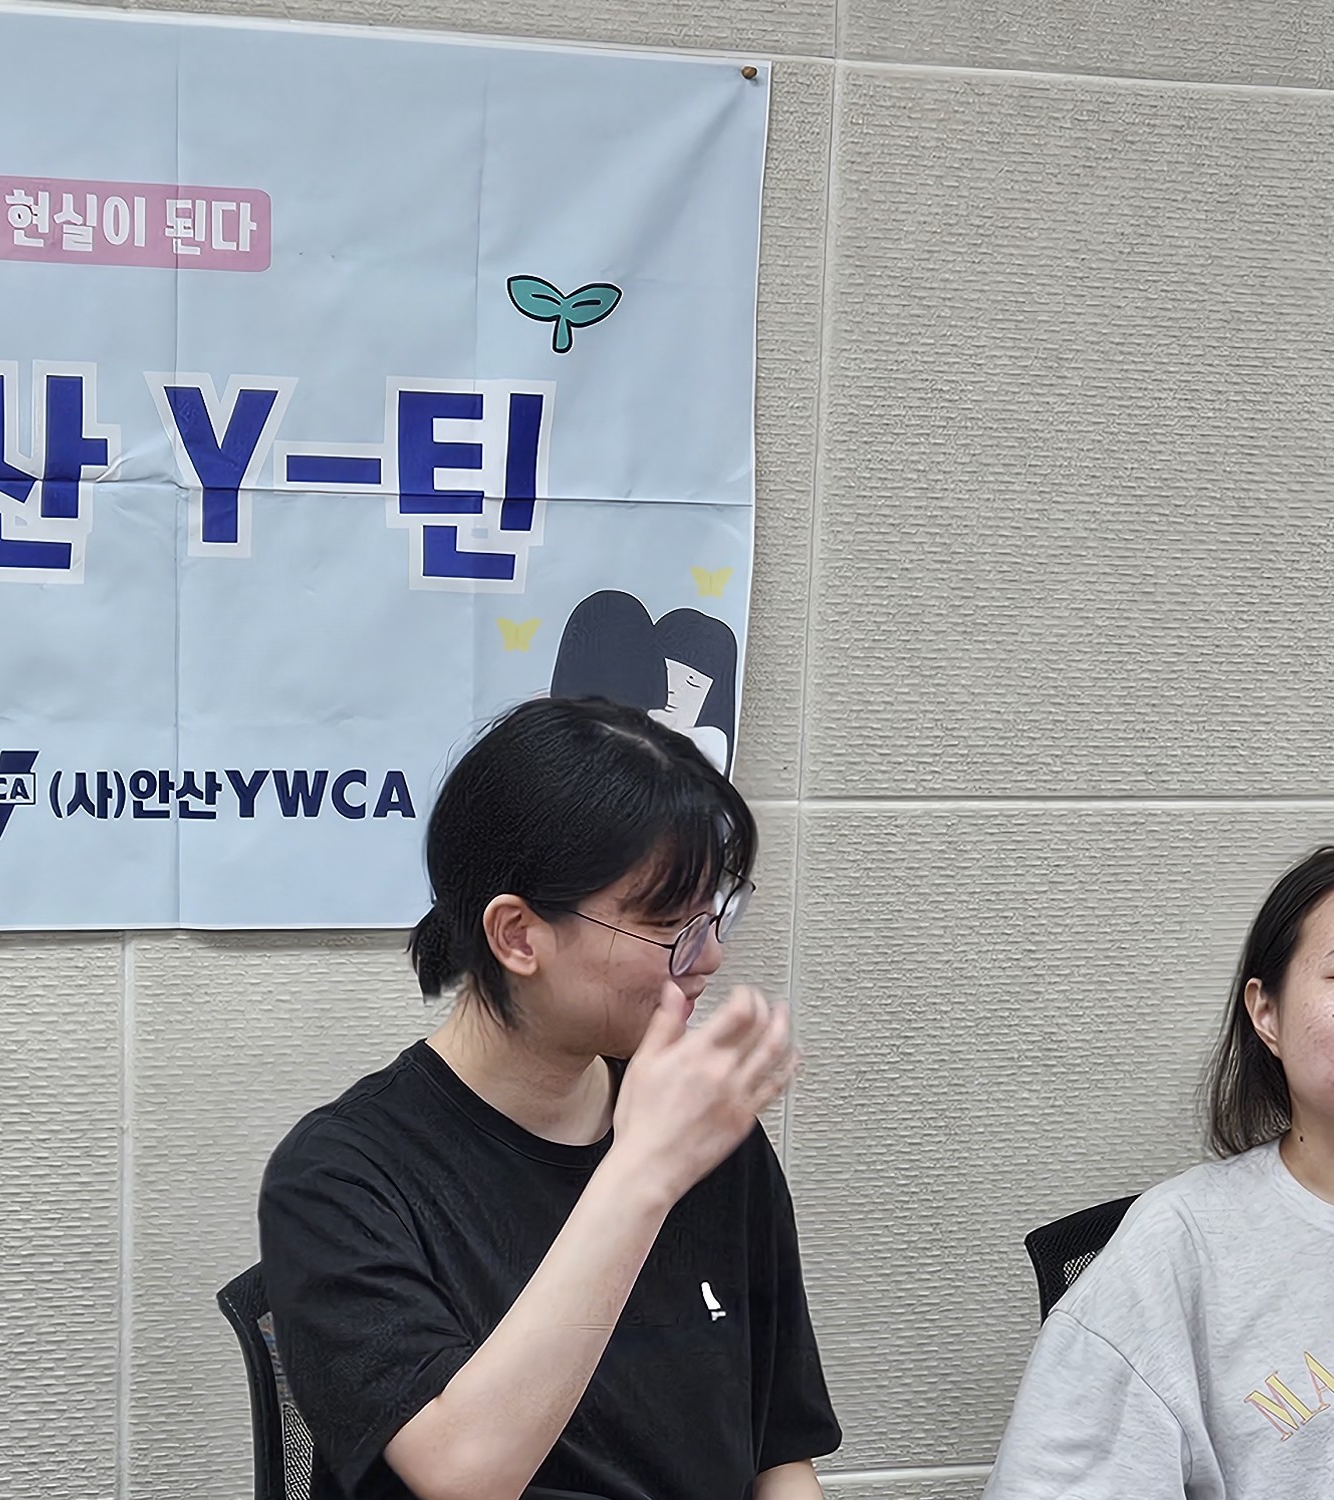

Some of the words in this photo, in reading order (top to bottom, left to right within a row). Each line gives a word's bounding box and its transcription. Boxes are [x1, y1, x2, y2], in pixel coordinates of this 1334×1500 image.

[4, 188, 146, 252] 현실이
[165, 197, 257, 255] 된다
[163, 383, 544, 581] Y-틴
[47, 768, 417, 820] (사)안산YWCA
